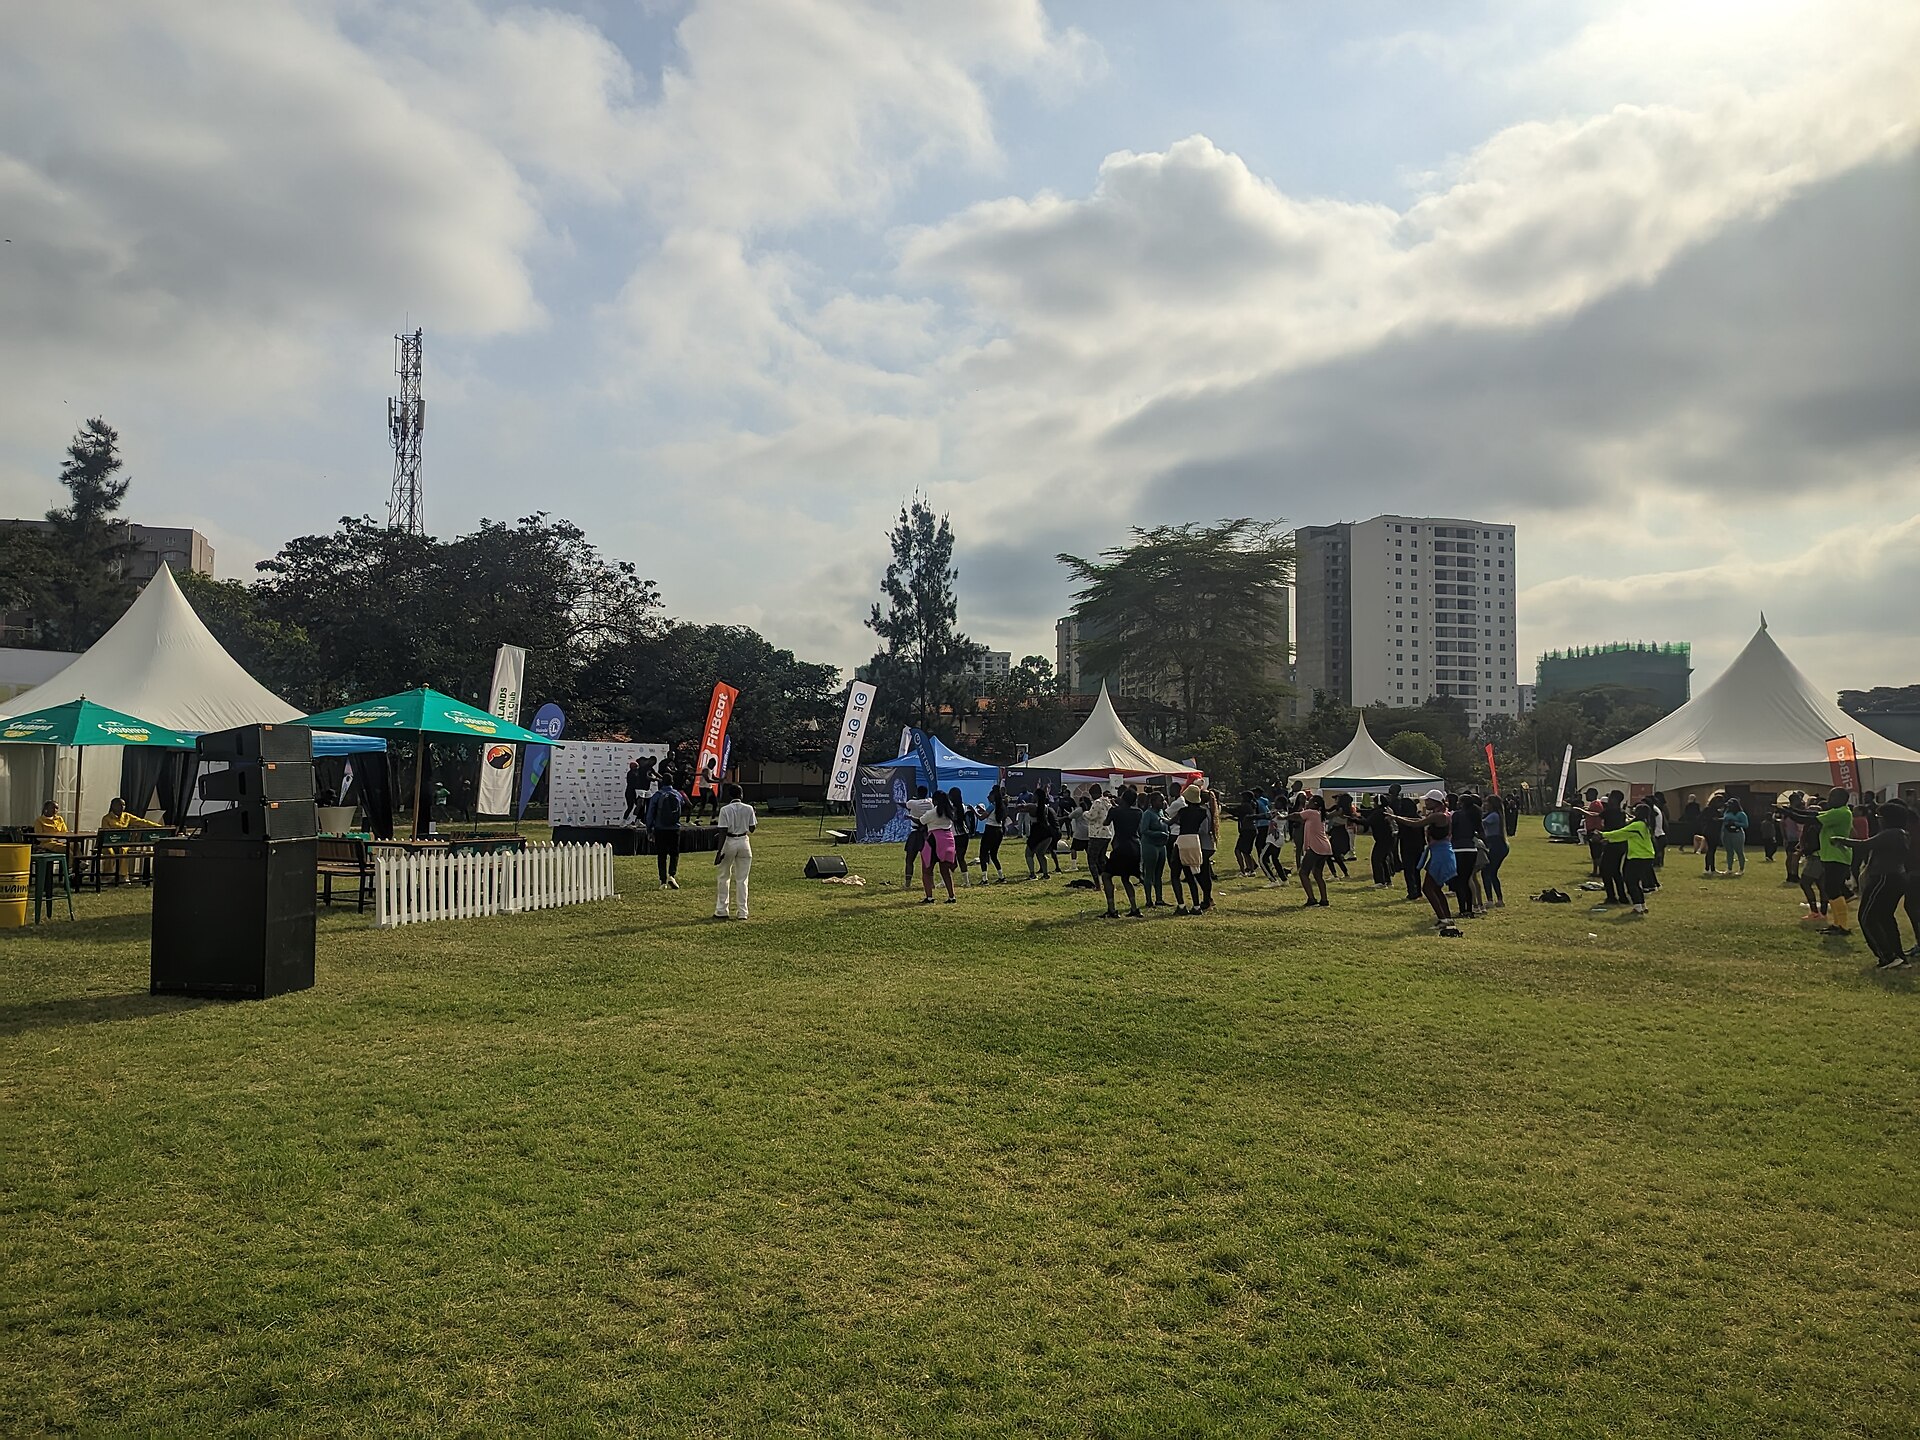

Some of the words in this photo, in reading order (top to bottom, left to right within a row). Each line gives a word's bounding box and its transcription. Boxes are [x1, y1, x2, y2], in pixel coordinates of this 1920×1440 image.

[498, 687, 508, 720] LANDS
[508, 692, 516, 709] Club
[707, 692, 728, 748] FitBeat
[0, 885, 29, 893] vann
